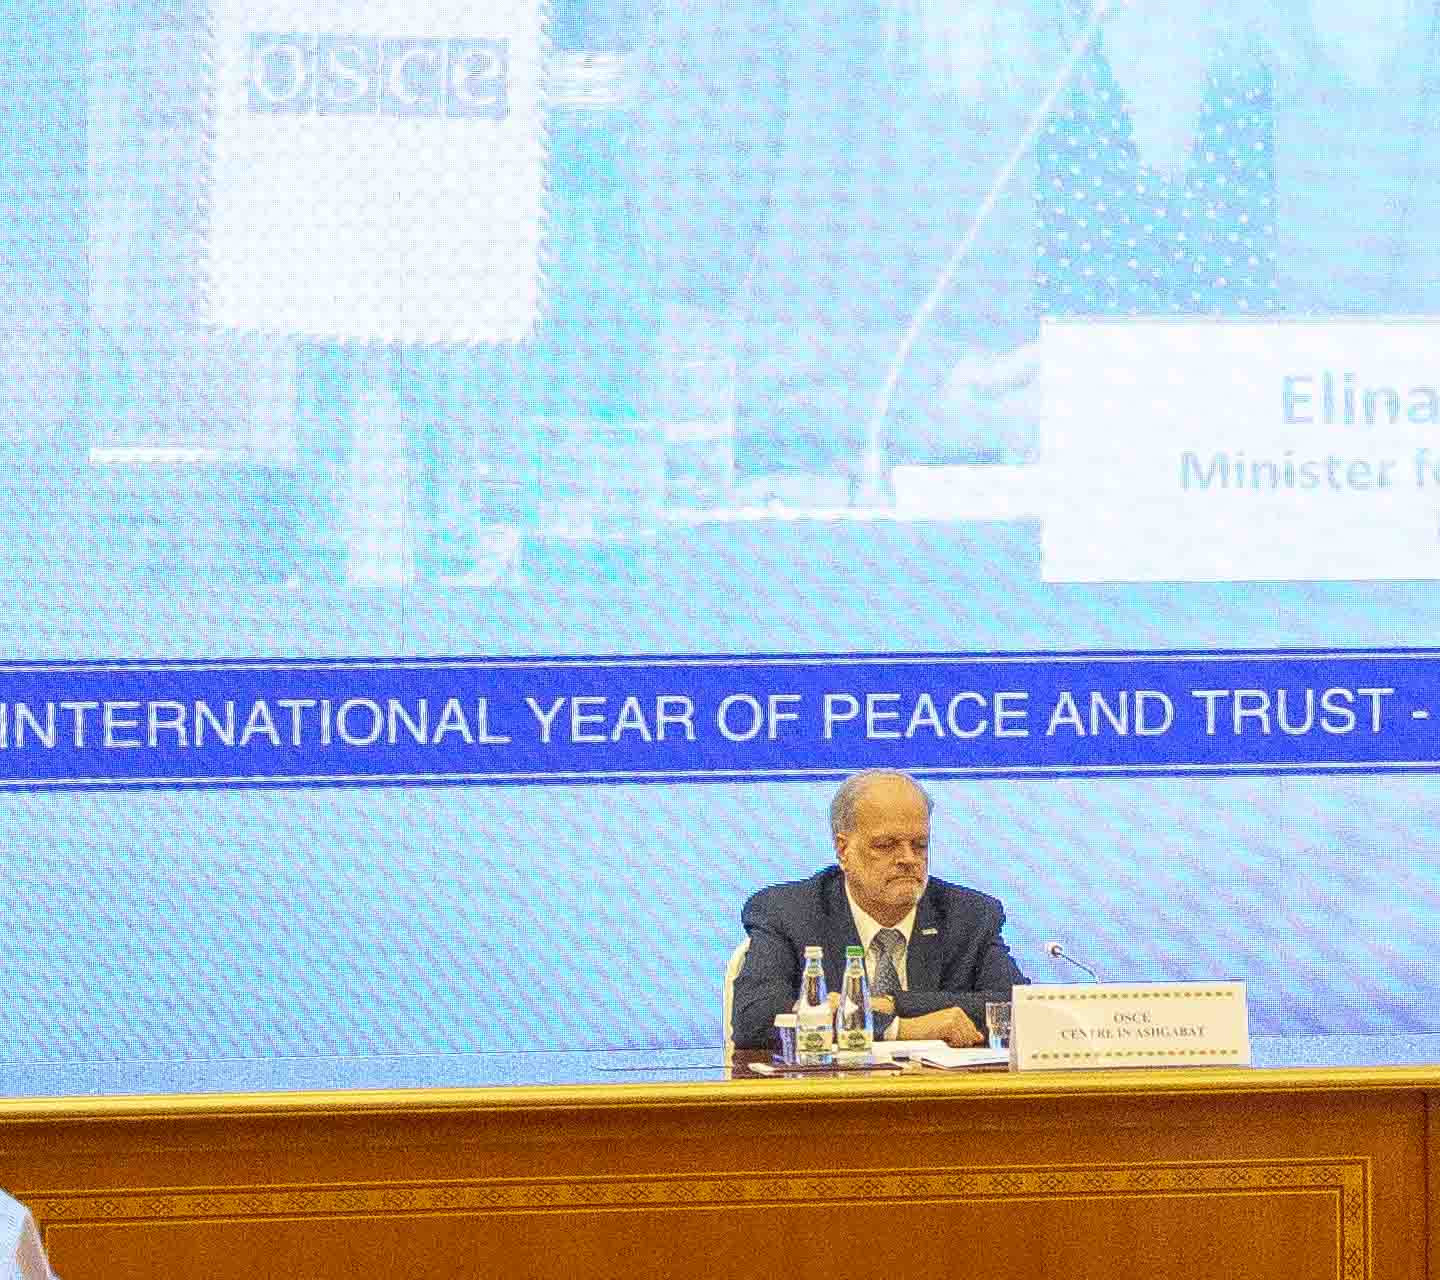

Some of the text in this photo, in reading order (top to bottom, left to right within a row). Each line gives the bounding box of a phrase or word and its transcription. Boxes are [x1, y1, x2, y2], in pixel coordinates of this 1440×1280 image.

[1179, 449, 1391, 491] Minister
[526, 695, 695, 743] YEAR
[716, 693, 801, 742] OF
[823, 691, 1028, 739] PEACE
[1046, 690, 1174, 736] AND
[1192, 687, 1393, 735] TRUST
[1113, 1011, 1152, 1024] OSCE
[1060, 1028, 1112, 1040] CENTRE
[1135, 1025, 1207, 1039] ASHGABAT
